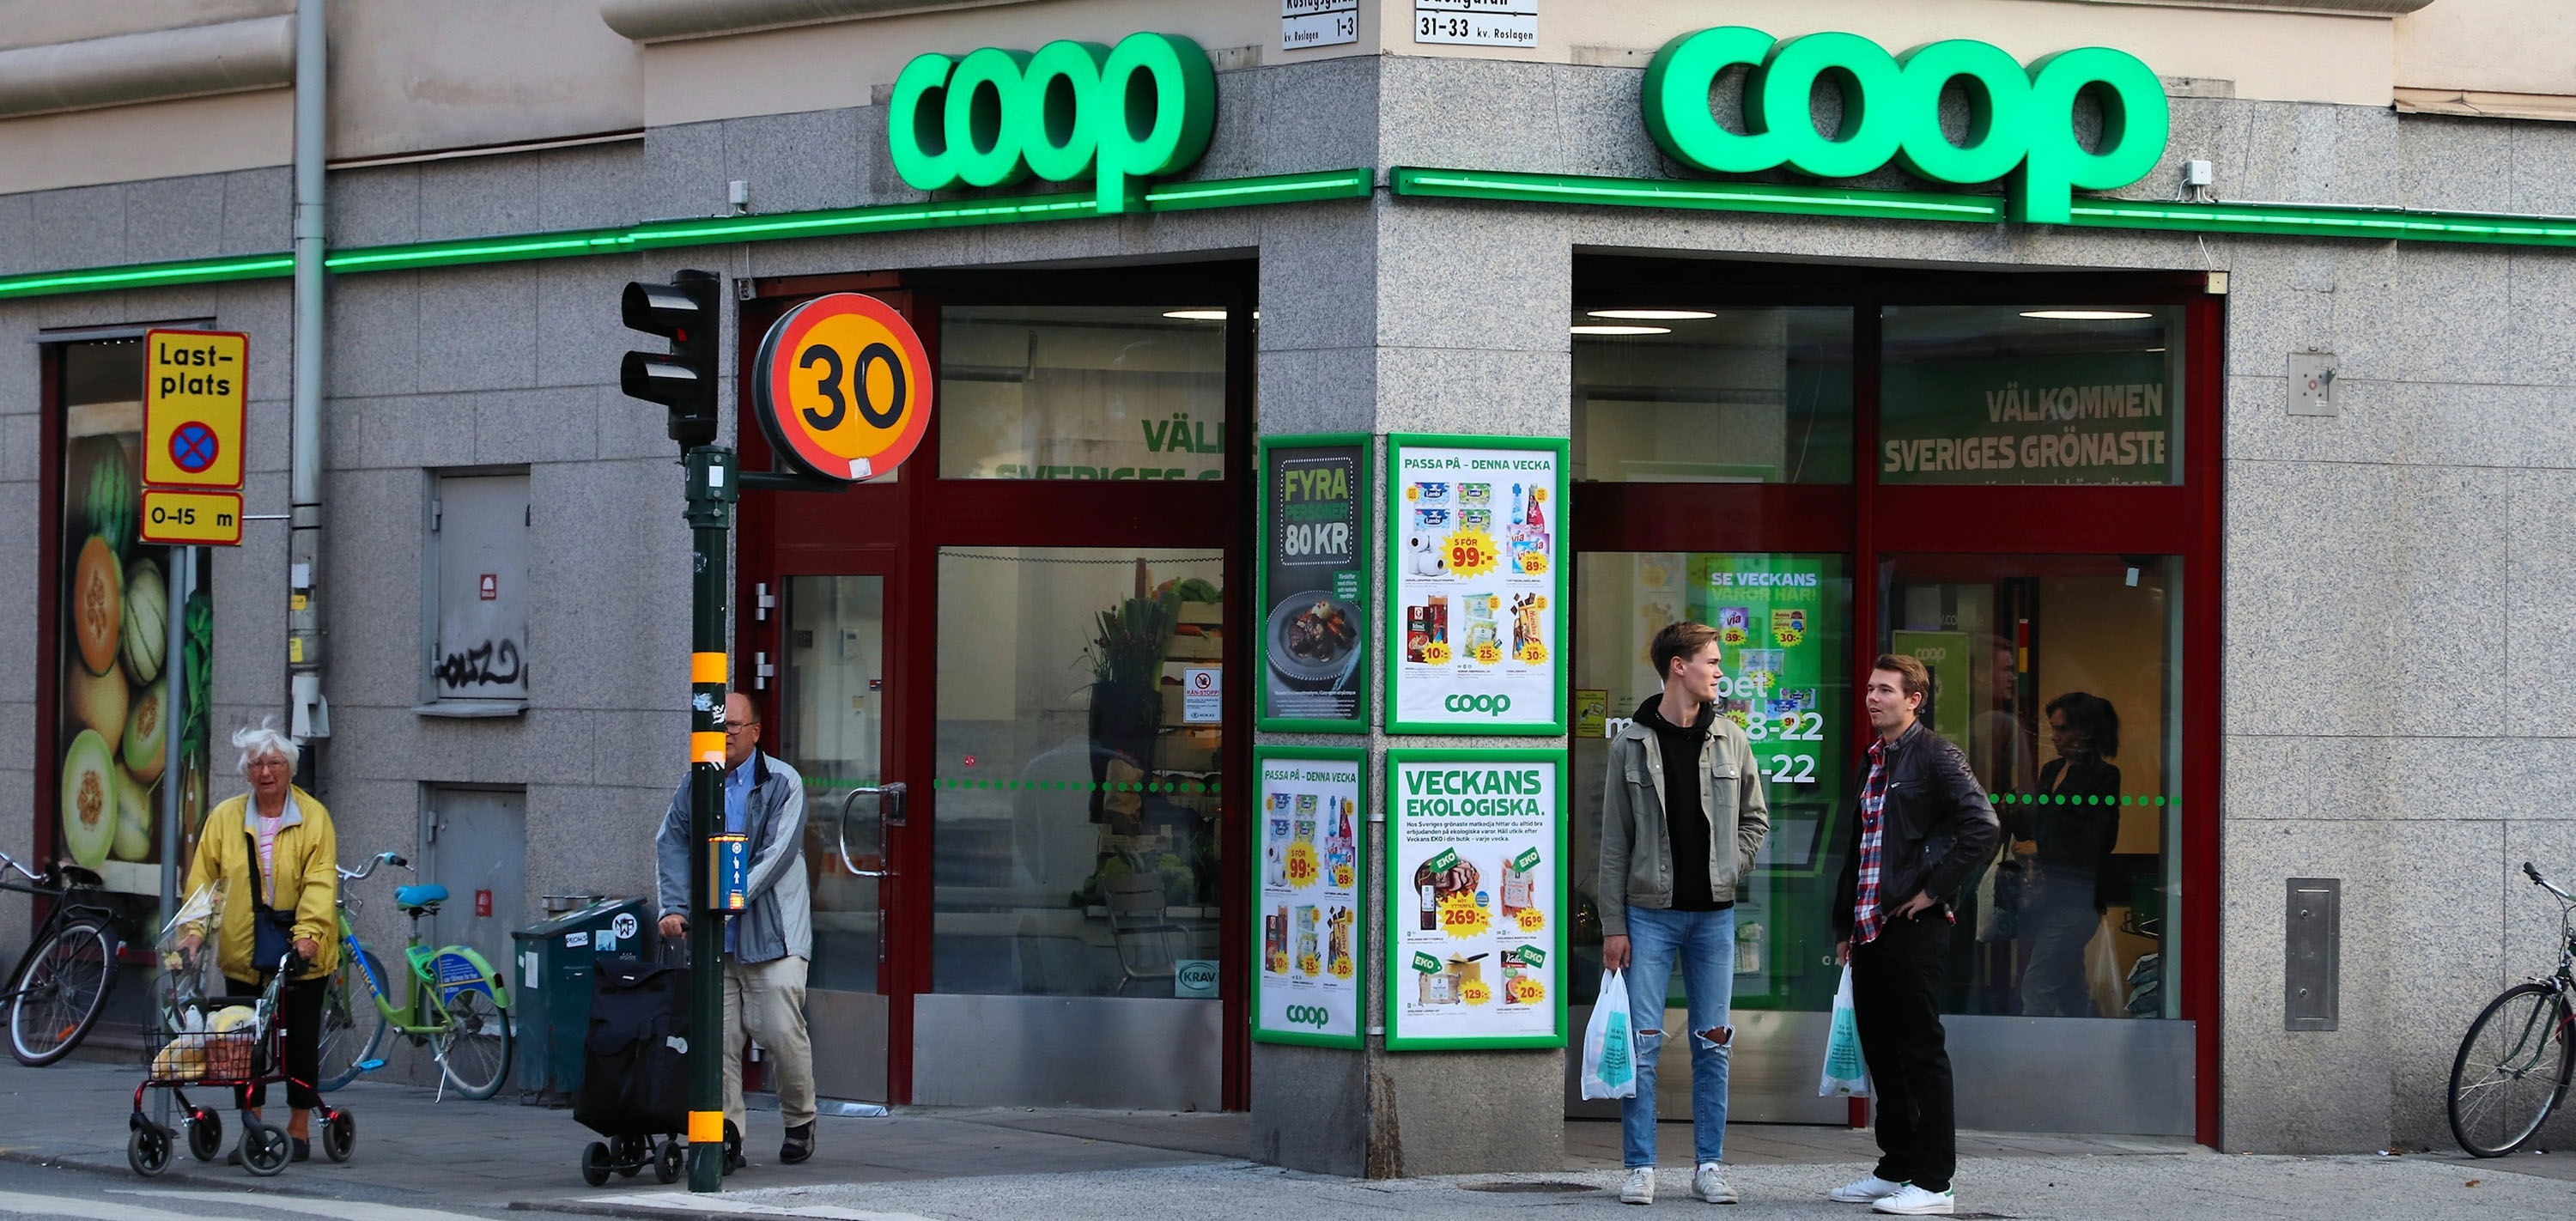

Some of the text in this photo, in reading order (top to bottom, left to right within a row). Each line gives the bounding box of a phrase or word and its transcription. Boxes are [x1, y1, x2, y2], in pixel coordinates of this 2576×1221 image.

[1295, 30, 1318, 42] Roslagen
[1337, 17, 1353, 36] 1-3
[1421, 17, 1533, 41] 31-33 kv. Roslagen
[889, 31, 1214, 213] coop
[1643, 26, 2169, 222] coop
[161, 343, 233, 367] Last-
[161, 373, 230, 398] plats
[799, 343, 907, 431] 30
[1985, 381, 2163, 423] VÄLKOMMEN
[1884, 435, 2016, 472] SVERIGES
[1405, 459, 1443, 469] PASSA
[1446, 457, 1461, 469] PÅ
[1472, 460, 1510, 470] DENNA
[1513, 460, 1551, 471] VECKA
[1285, 468, 1348, 501] FYRA
[152, 507, 233, 526] 0-15 m
[1285, 522, 1349, 556] 80 KR
[1453, 547, 1492, 567] 99:-
[1525, 561, 1546, 571] 89:-
[1711, 573, 1817, 586] SE VECKANS
[1527, 651, 1545, 660] 30:-
[1915, 647, 1946, 663] coop
[1445, 695, 1510, 717] coop
[1265, 770, 1288, 781] PASSA
[1290, 768, 1300, 781] PÅ
[1307, 772, 1330, 781] DENNA
[1332, 773, 1356, 783] VECKA
[1405, 770, 1541, 795] VECKANS
[1406, 799, 1545, 817] EKOLOGISKA.
[1290, 858, 1315, 878] 99:-
[1437, 853, 1455, 868] EKO
[1519, 852, 1538, 867] EKO
[1445, 909, 1485, 925] 269:-
[1415, 957, 1434, 969] EKO
[1524, 951, 1543, 963] EKO
[1184, 972, 1216, 982] KRAV
[1520, 987, 1542, 997] 20:-
[1286, 1005, 1329, 1030] coop
